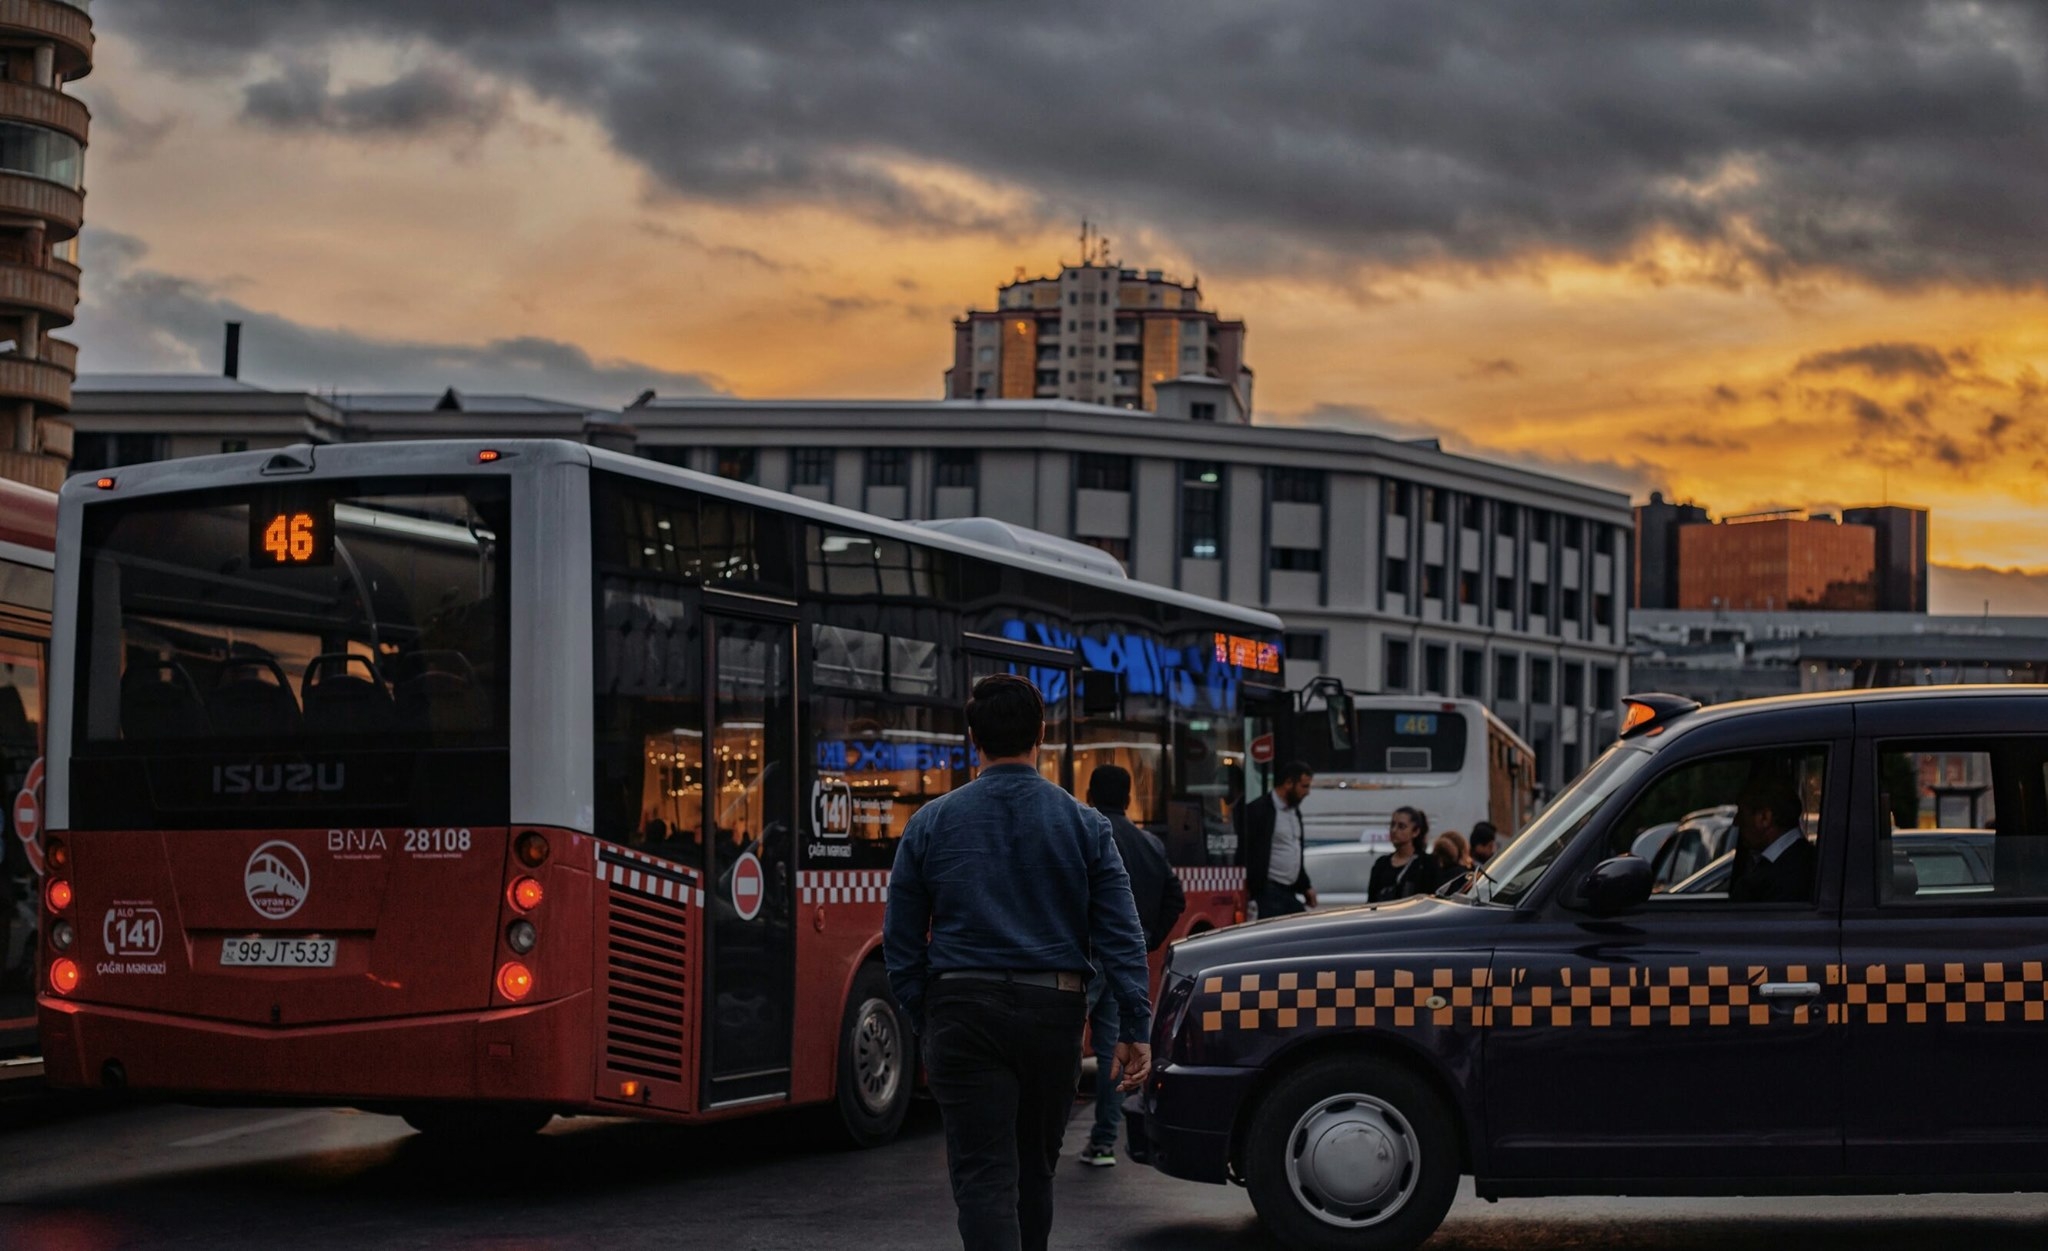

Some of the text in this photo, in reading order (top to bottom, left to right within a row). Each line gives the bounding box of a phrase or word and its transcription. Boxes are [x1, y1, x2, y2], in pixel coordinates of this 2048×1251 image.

[266, 514, 313, 561] 46
[1404, 715, 1429, 735] 46
[213, 762, 345, 794] ISUZU
[820, 793, 847, 829] 141
[328, 829, 387, 851] BNA
[404, 828, 471, 852] 28108
[115, 919, 156, 949] 141
[96, 960, 125, 976] ÇAĞRI
